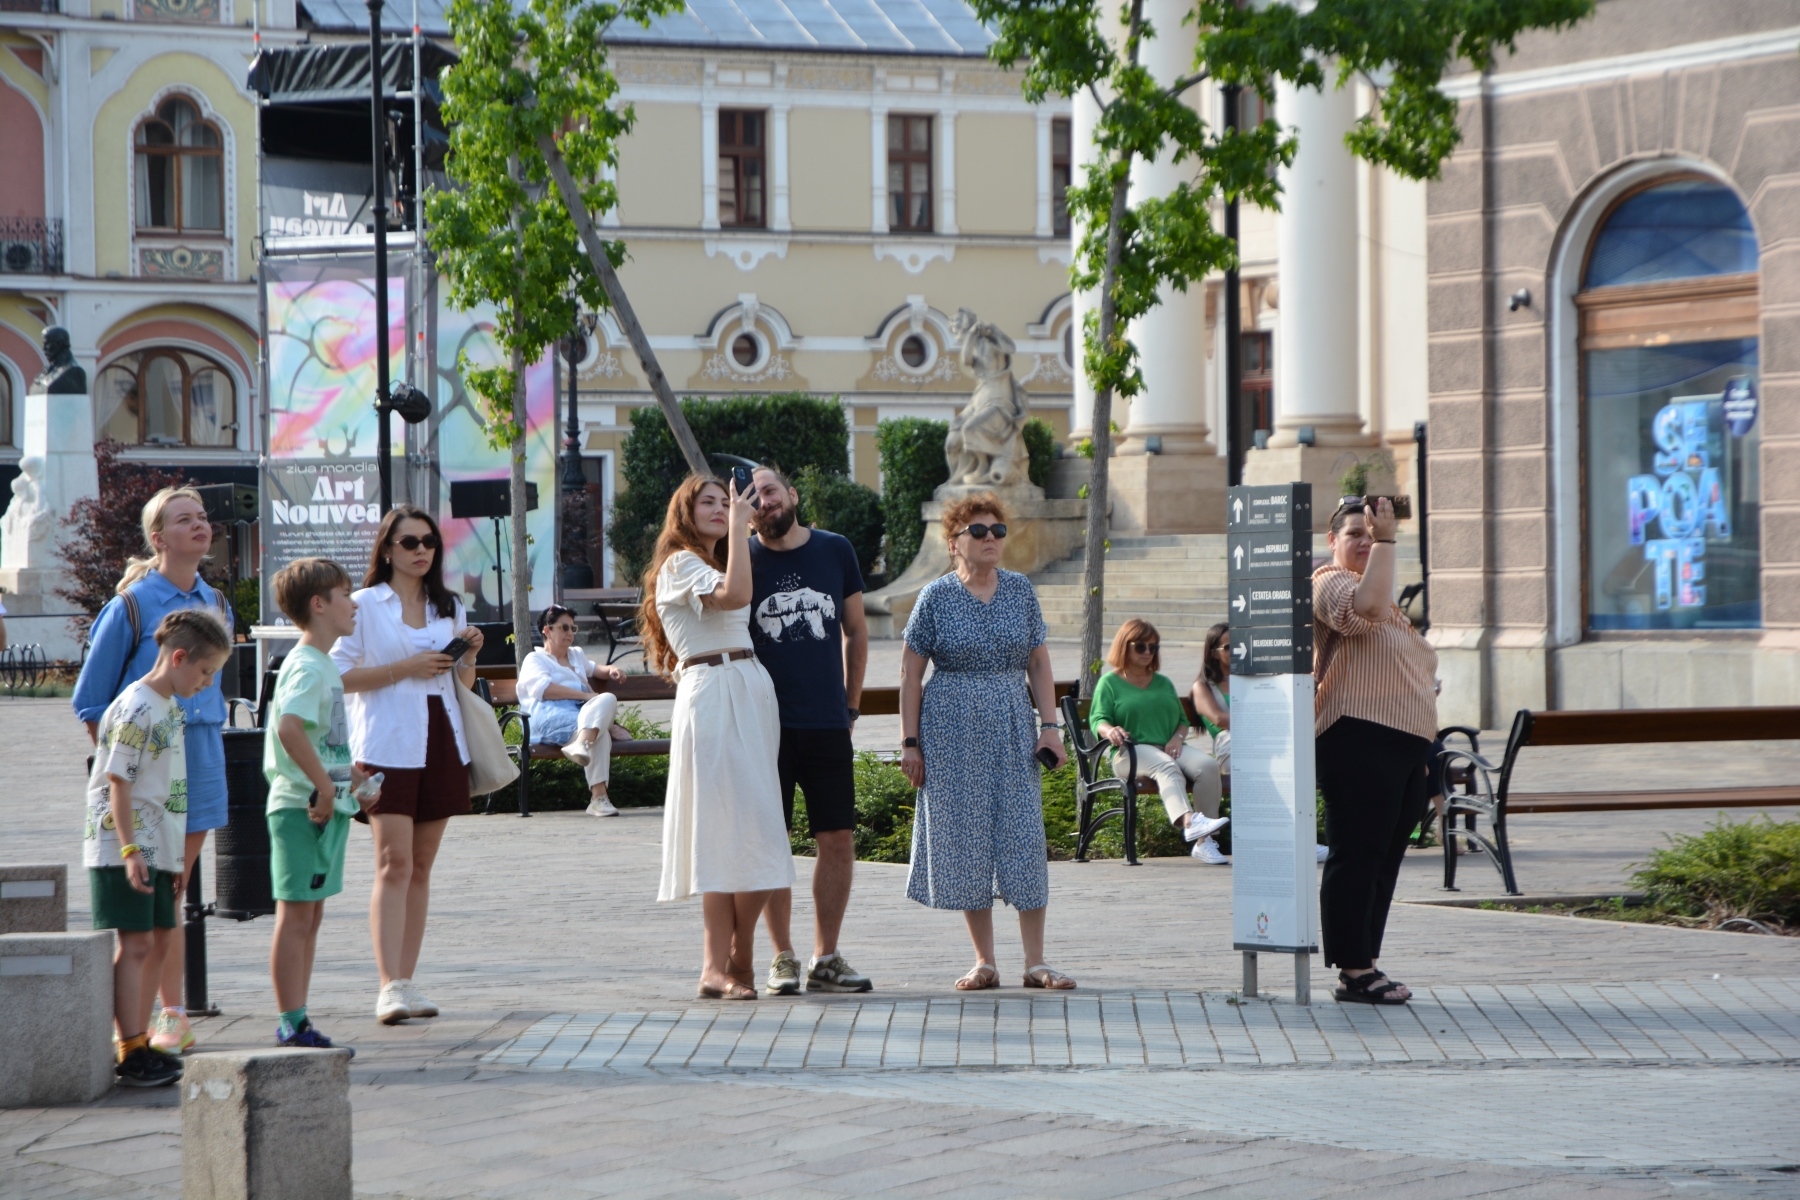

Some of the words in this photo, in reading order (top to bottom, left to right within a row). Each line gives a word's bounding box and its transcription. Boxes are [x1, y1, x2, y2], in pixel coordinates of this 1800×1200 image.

[286, 464, 317, 474] ziua
[321, 461, 380, 474] mondial
[311, 475, 366, 501] Art
[1271, 495, 1287, 505] BAROC
[272, 500, 406, 525] Nouvea
[1252, 590, 1271, 600] CETATEA
[1272, 590, 1292, 600] ORADEA
[1253, 639, 1274, 648] BELVEDERE
[1274, 638, 1292, 647] CIUPERCA
